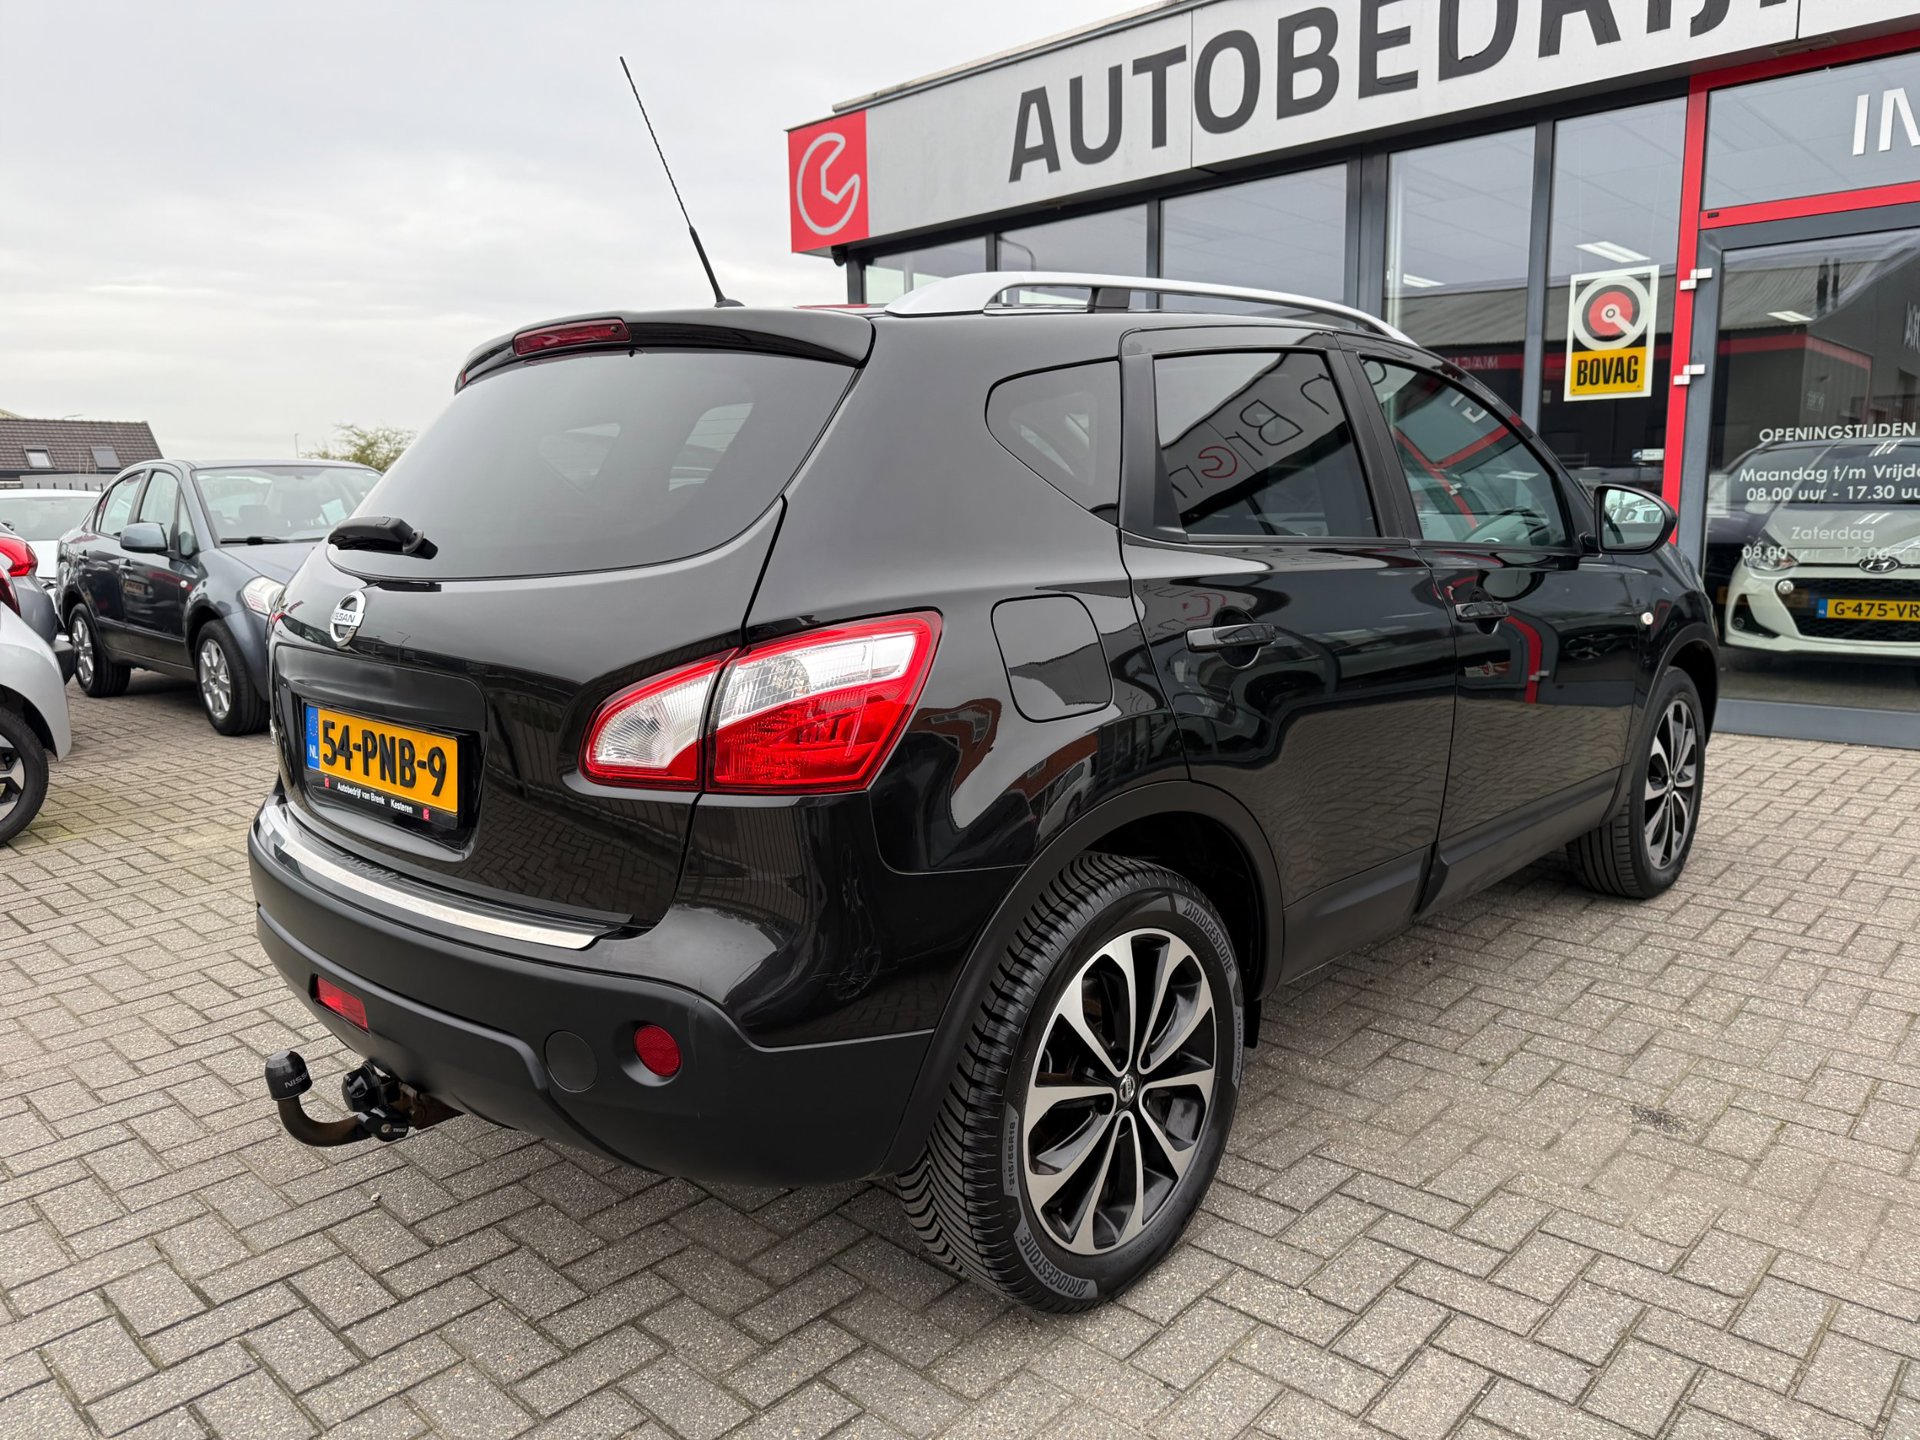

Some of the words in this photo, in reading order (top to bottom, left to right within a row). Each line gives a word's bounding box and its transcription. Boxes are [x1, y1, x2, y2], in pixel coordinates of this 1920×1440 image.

[1576, 355, 1639, 386] BOVAG
[1759, 421, 1917, 443] OPENINGSTIJDEN
[1739, 466, 1828, 483] Maandag
[1833, 465, 1866, 481] t/m
[1746, 486, 1793, 501] 08.00
[1798, 488, 1827, 500] uur
[1847, 484, 1895, 499] 17.30
[1791, 526, 1875, 543] Zaterdag
[1742, 545, 1788, 559] 08.00
[309, 743, 319, 760] NL
[322, 720, 447, 797] 54-PNB-9
[336, 782, 362, 799] Autobedrijf
[361, 791, 371, 801] van
[370, 793, 386, 805] Brenk
[390, 799, 414, 814] Kesteren
[1182, 901, 1235, 975] BRIDGESTONE
[284, 1070, 308, 1089] NISS
[1019, 1231, 1089, 1298] BRIDGESTONE
